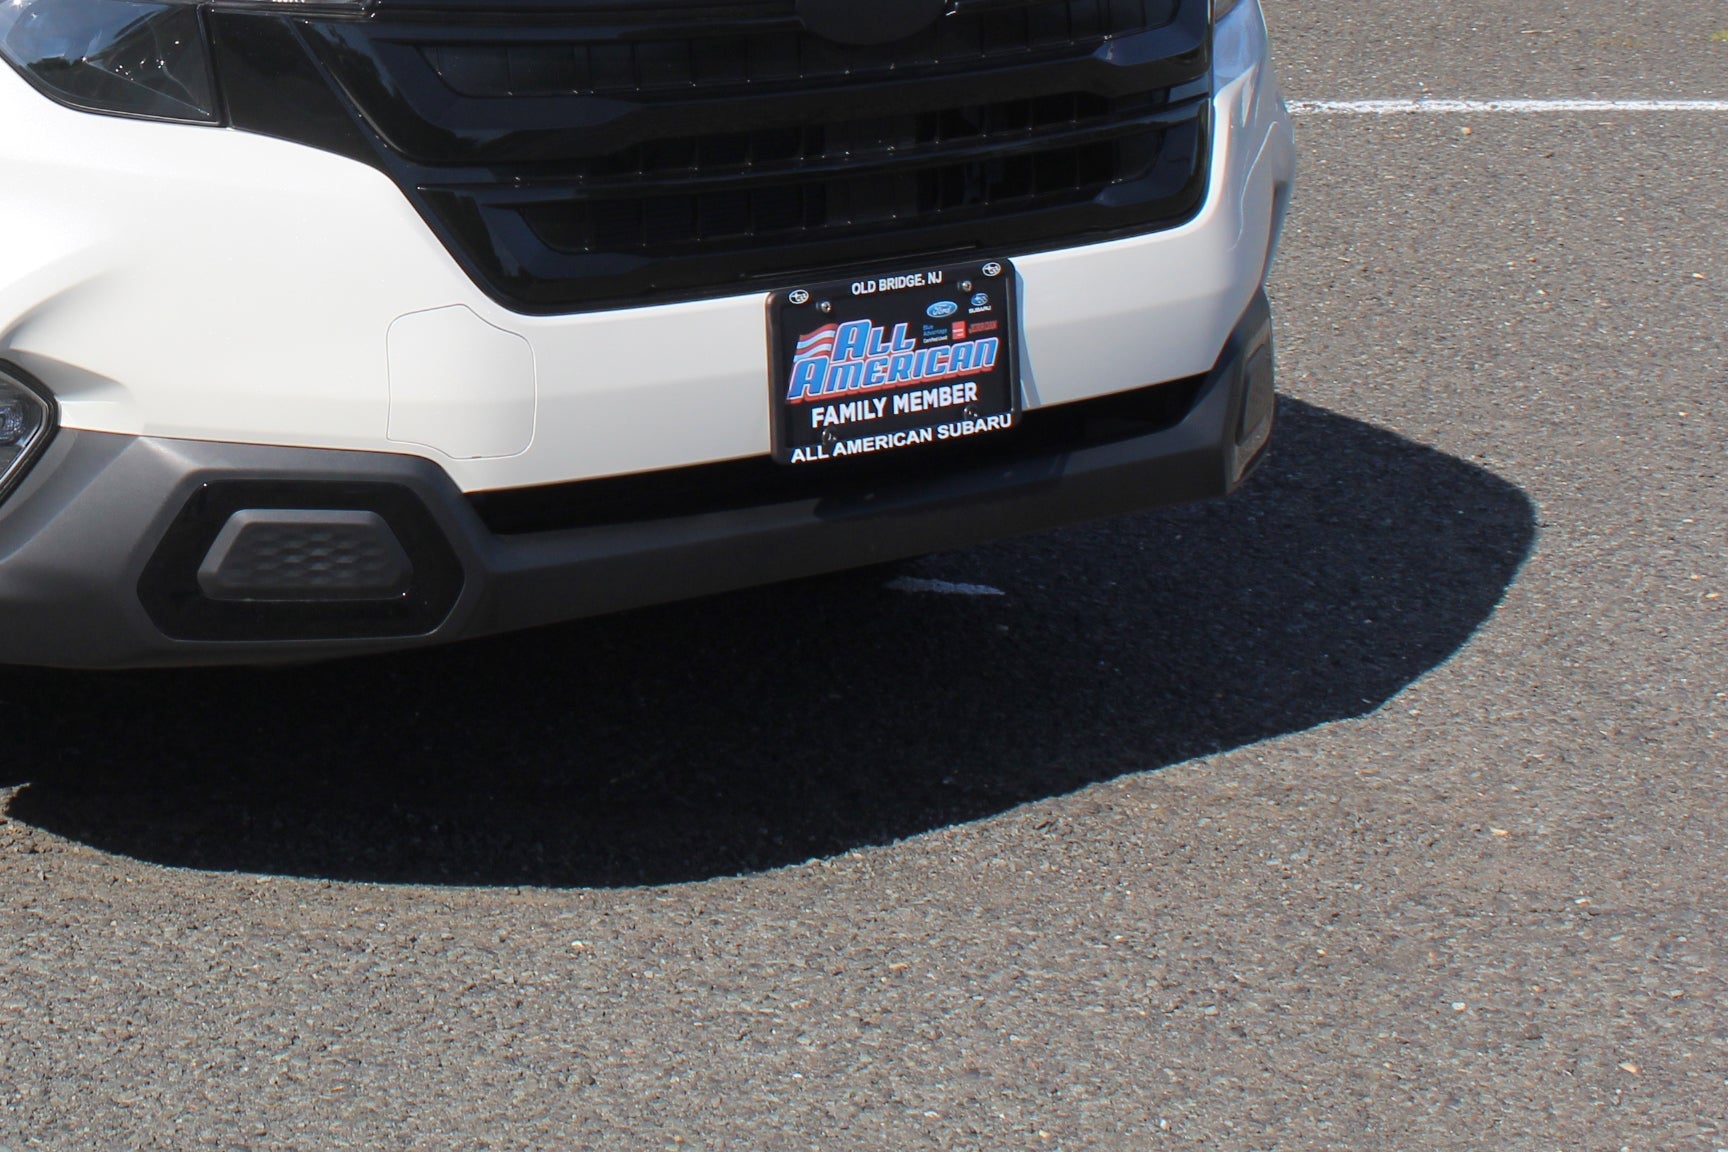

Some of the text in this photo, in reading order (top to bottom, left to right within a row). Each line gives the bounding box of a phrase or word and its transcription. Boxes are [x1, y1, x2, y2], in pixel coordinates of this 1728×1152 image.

[851, 270, 943, 296] OLD BRIDGE, NJ
[929, 302, 954, 316] Ford
[811, 382, 978, 428] FAMILY MEMBER
[790, 413, 1012, 464] ALL AMERICAN SUBARU
